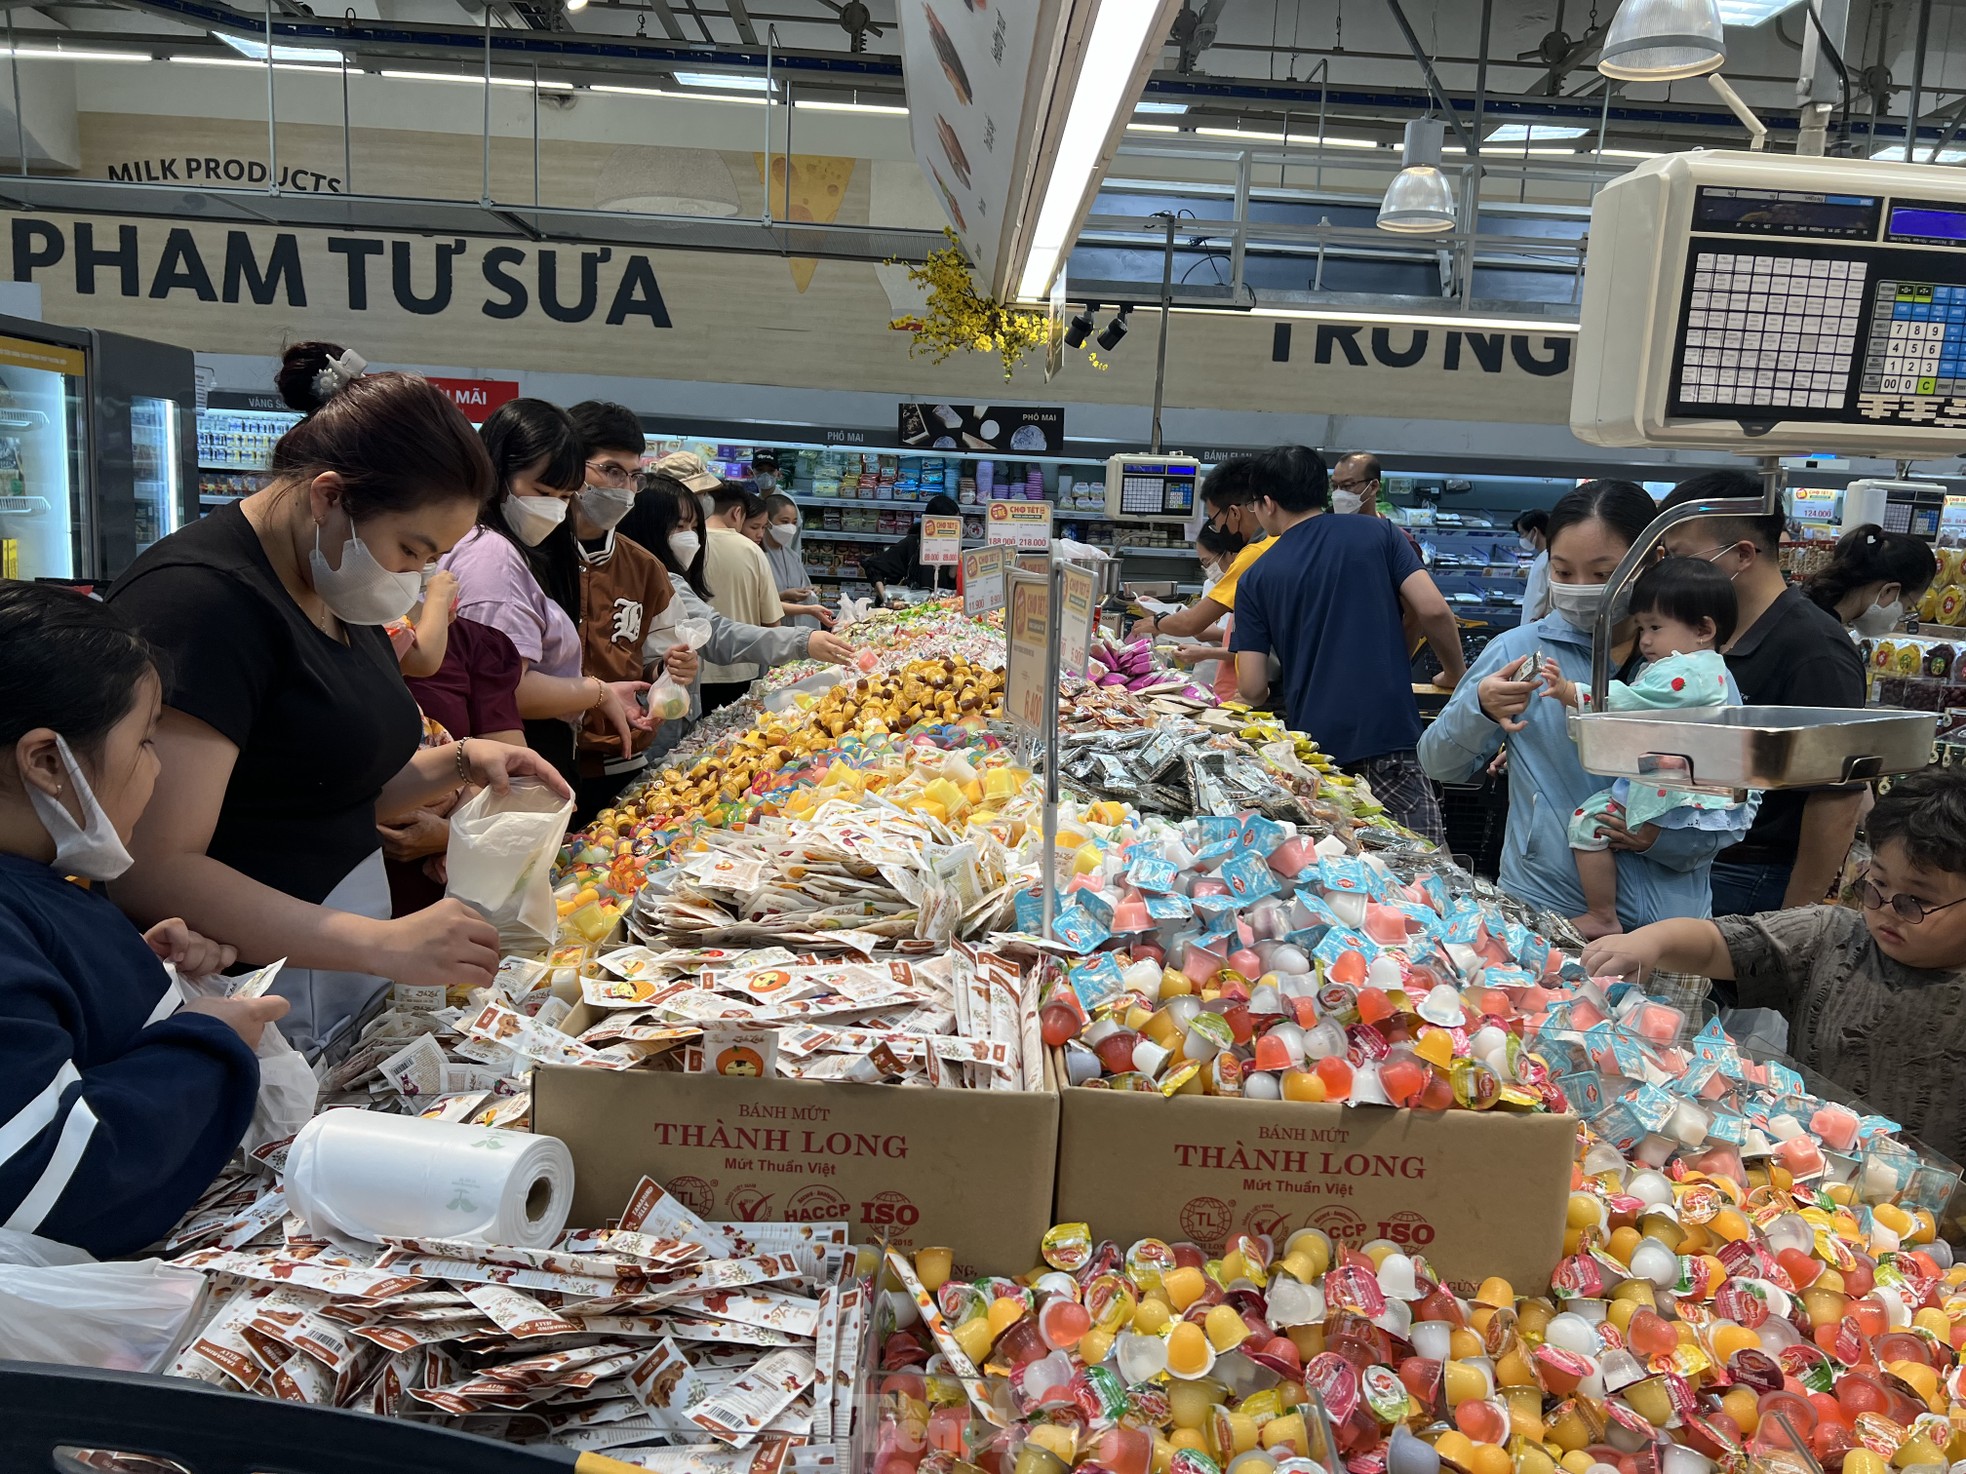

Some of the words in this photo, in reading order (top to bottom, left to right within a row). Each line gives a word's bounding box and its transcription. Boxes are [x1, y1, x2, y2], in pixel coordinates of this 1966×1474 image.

[107, 158, 180, 182] MILK
[185, 157, 342, 193] PRODUCTS
[1896, 324, 1903, 334] 7
[1914, 325, 1921, 335] 8
[1932, 327, 1939, 337] 9
[1892, 343, 1899, 353] 4
[1911, 344, 1918, 353] 5
[1929, 345, 1936, 355] 6
[1890, 361, 1896, 371] 1
[1908, 362, 1915, 372] 2
[1926, 363, 1933, 373] 3
[1884, 379, 1897, 389] 00
[1922, 381, 1930, 391] C
[456, 387, 487, 405] MÃI
[847, 433, 864, 442] MAI
[1204, 450, 1228, 460] BÁNH
[739, 1104, 786, 1120] BÁNH
[792, 1105, 831, 1121] MỨT
[654, 1118, 791, 1152] THÀNH
[801, 1130, 909, 1159] LONG
[1259, 1124, 1306, 1141] BÁNH
[1311, 1127, 1350, 1144] MỨT
[725, 1157, 754, 1170] Mứt
[807, 1162, 836, 1178] Việt
[1174, 1140, 1309, 1173] THÀNH
[1319, 1152, 1427, 1180] LONG
[1243, 1178, 1272, 1191] Mứt
[1325, 1182, 1354, 1198] Việt
[677, 1191, 699, 1207] TL
[784, 1202, 851, 1223] HACCP
[860, 1202, 920, 1227] ISO
[1195, 1211, 1217, 1227] TL
[1377, 1222, 1436, 1246] ISO
[1726, 1289, 1742, 1322] Tropical
[1735, 1369, 1768, 1386] Tropical
